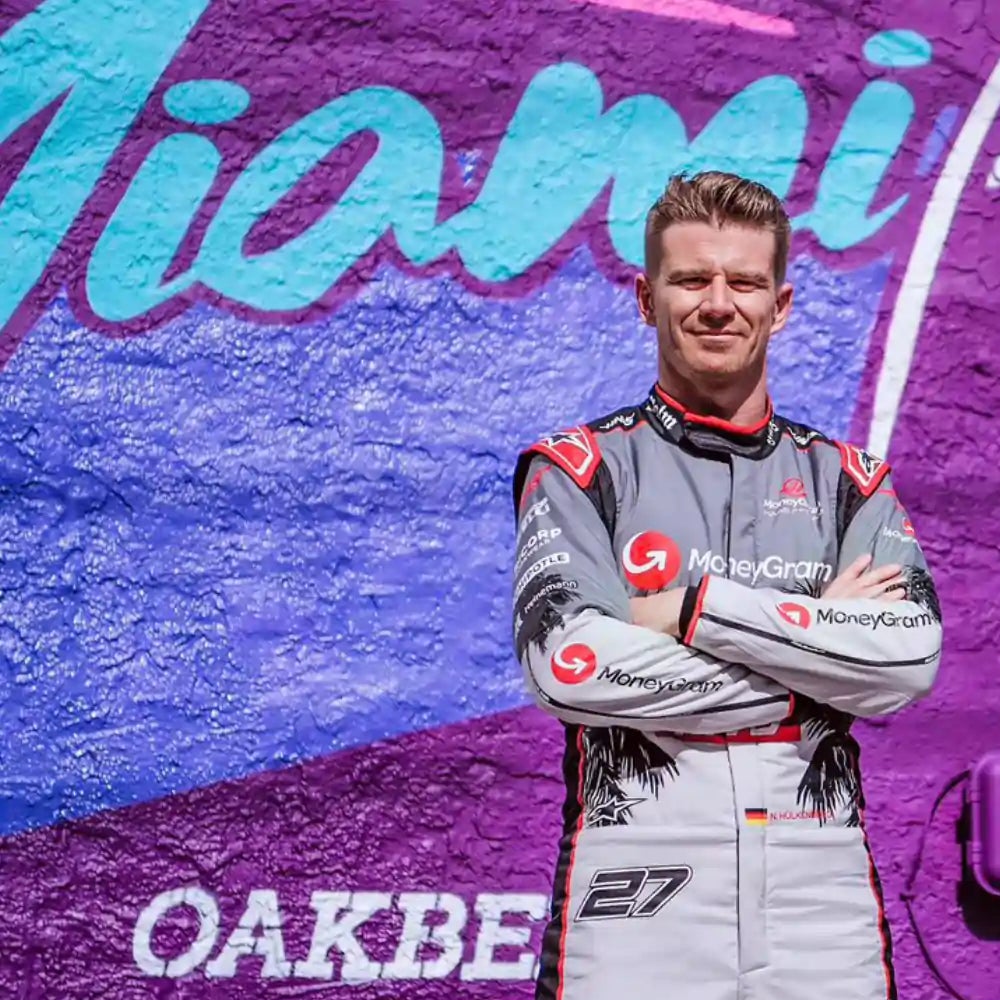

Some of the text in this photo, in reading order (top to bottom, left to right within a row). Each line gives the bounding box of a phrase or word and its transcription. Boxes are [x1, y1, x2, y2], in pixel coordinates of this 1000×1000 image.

[688, 548, 833, 583] MoneyGram
[816, 607, 934, 631] MoneyGram
[597, 665, 723, 695] MoneyGram
[574, 864, 694, 922] 27
[132, 887, 552, 981] OAKBE
